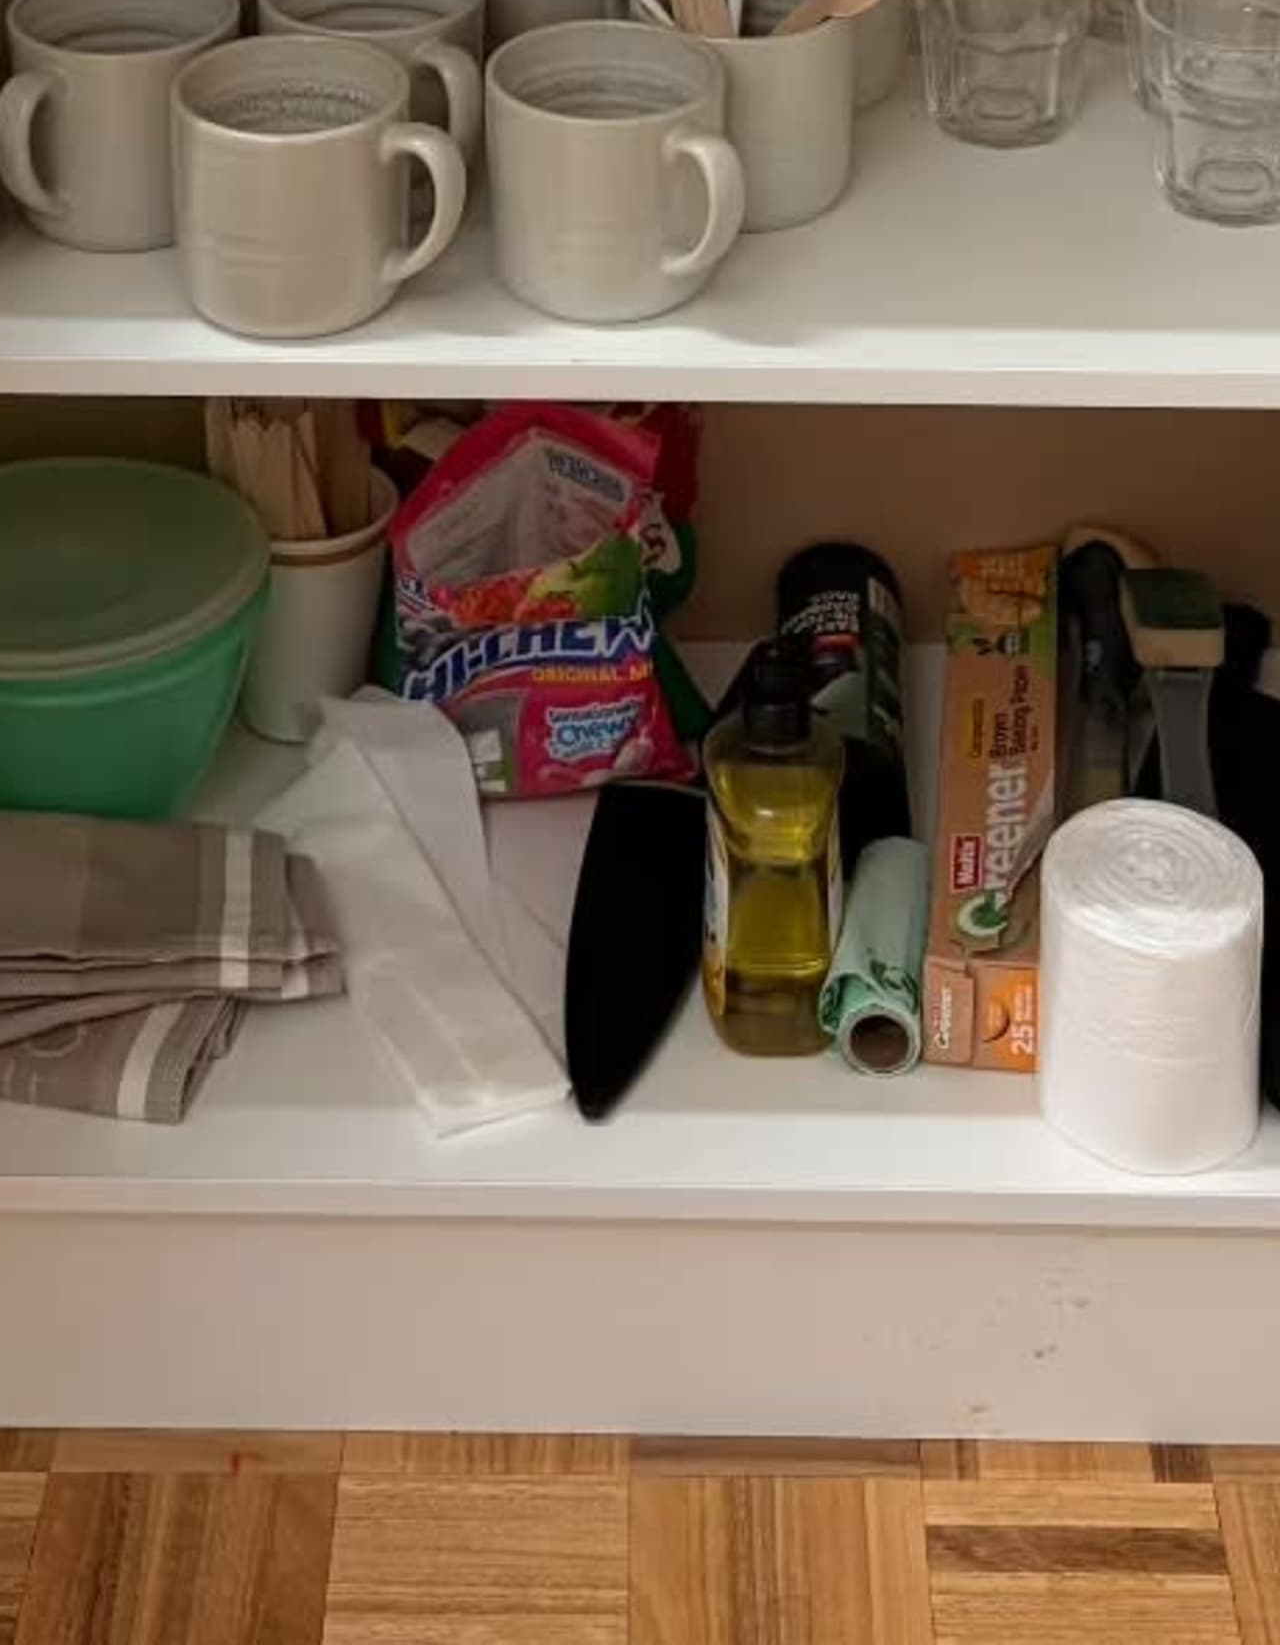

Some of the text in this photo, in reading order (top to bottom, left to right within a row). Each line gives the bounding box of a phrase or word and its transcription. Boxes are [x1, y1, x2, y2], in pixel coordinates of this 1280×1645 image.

[532, 664, 623, 684] ORIGINAL
[990, 712, 1008, 758] Brown
[1011, 1023, 1034, 1056] 25
